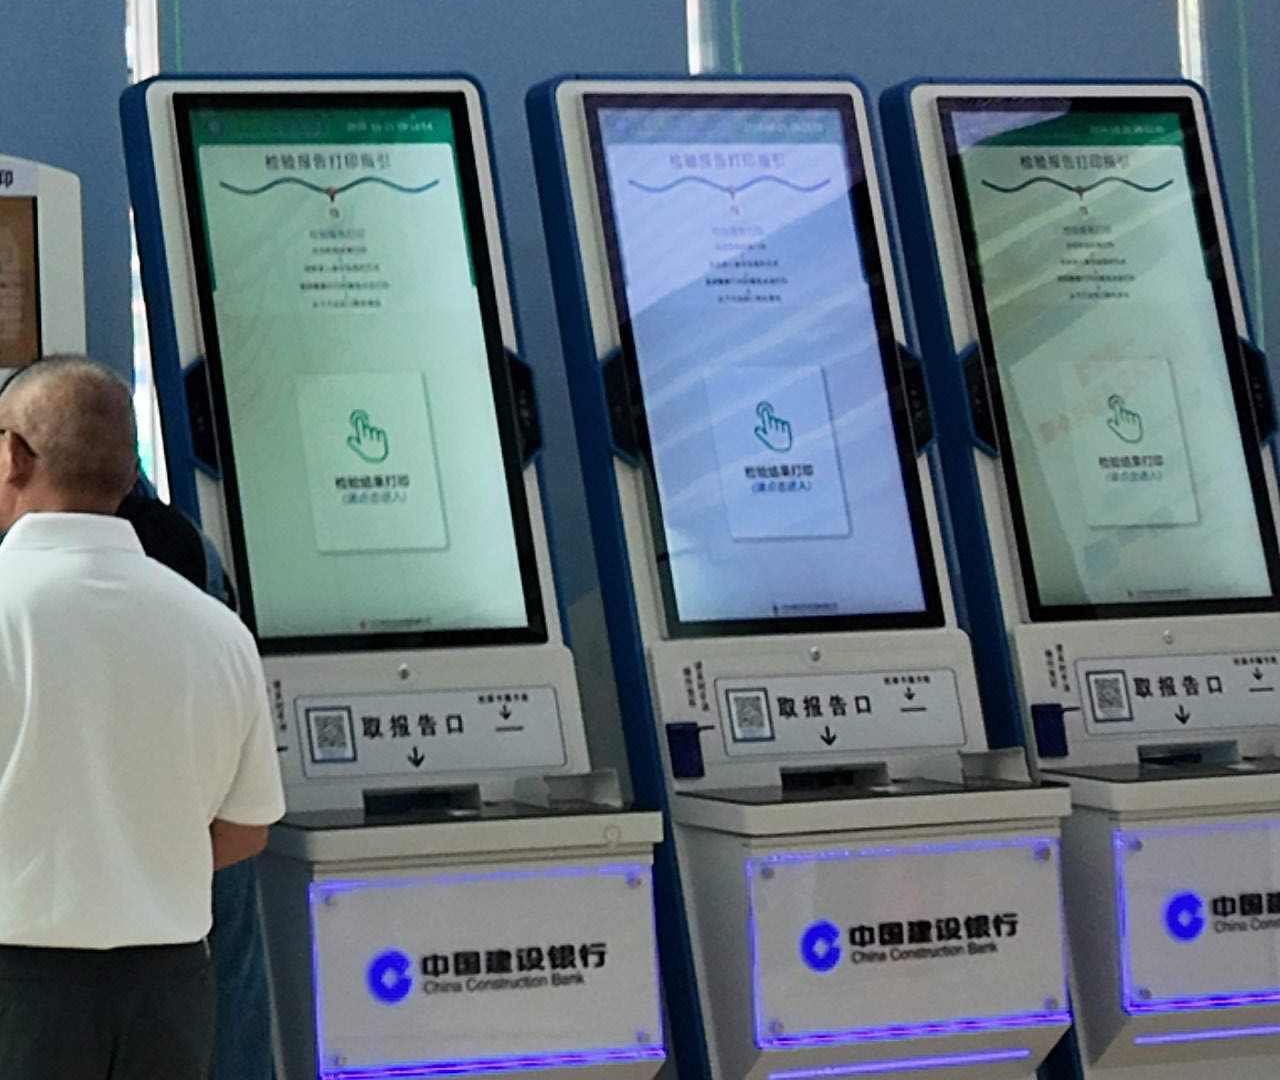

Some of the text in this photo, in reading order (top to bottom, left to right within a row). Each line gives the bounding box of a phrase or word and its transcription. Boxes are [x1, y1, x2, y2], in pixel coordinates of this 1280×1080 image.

[1133, 675, 1223, 699] 取报告口
[777, 694, 873, 720] 取报告口
[361, 714, 464, 740] 取报告口
[849, 913, 1018, 948] 中国建设银行
[1215, 919, 1249, 934] China
[421, 943, 607, 977] 中国建设银行
[851, 941, 998, 964] China Construction Bank
[423, 972, 584, 995] China Construction Bank
